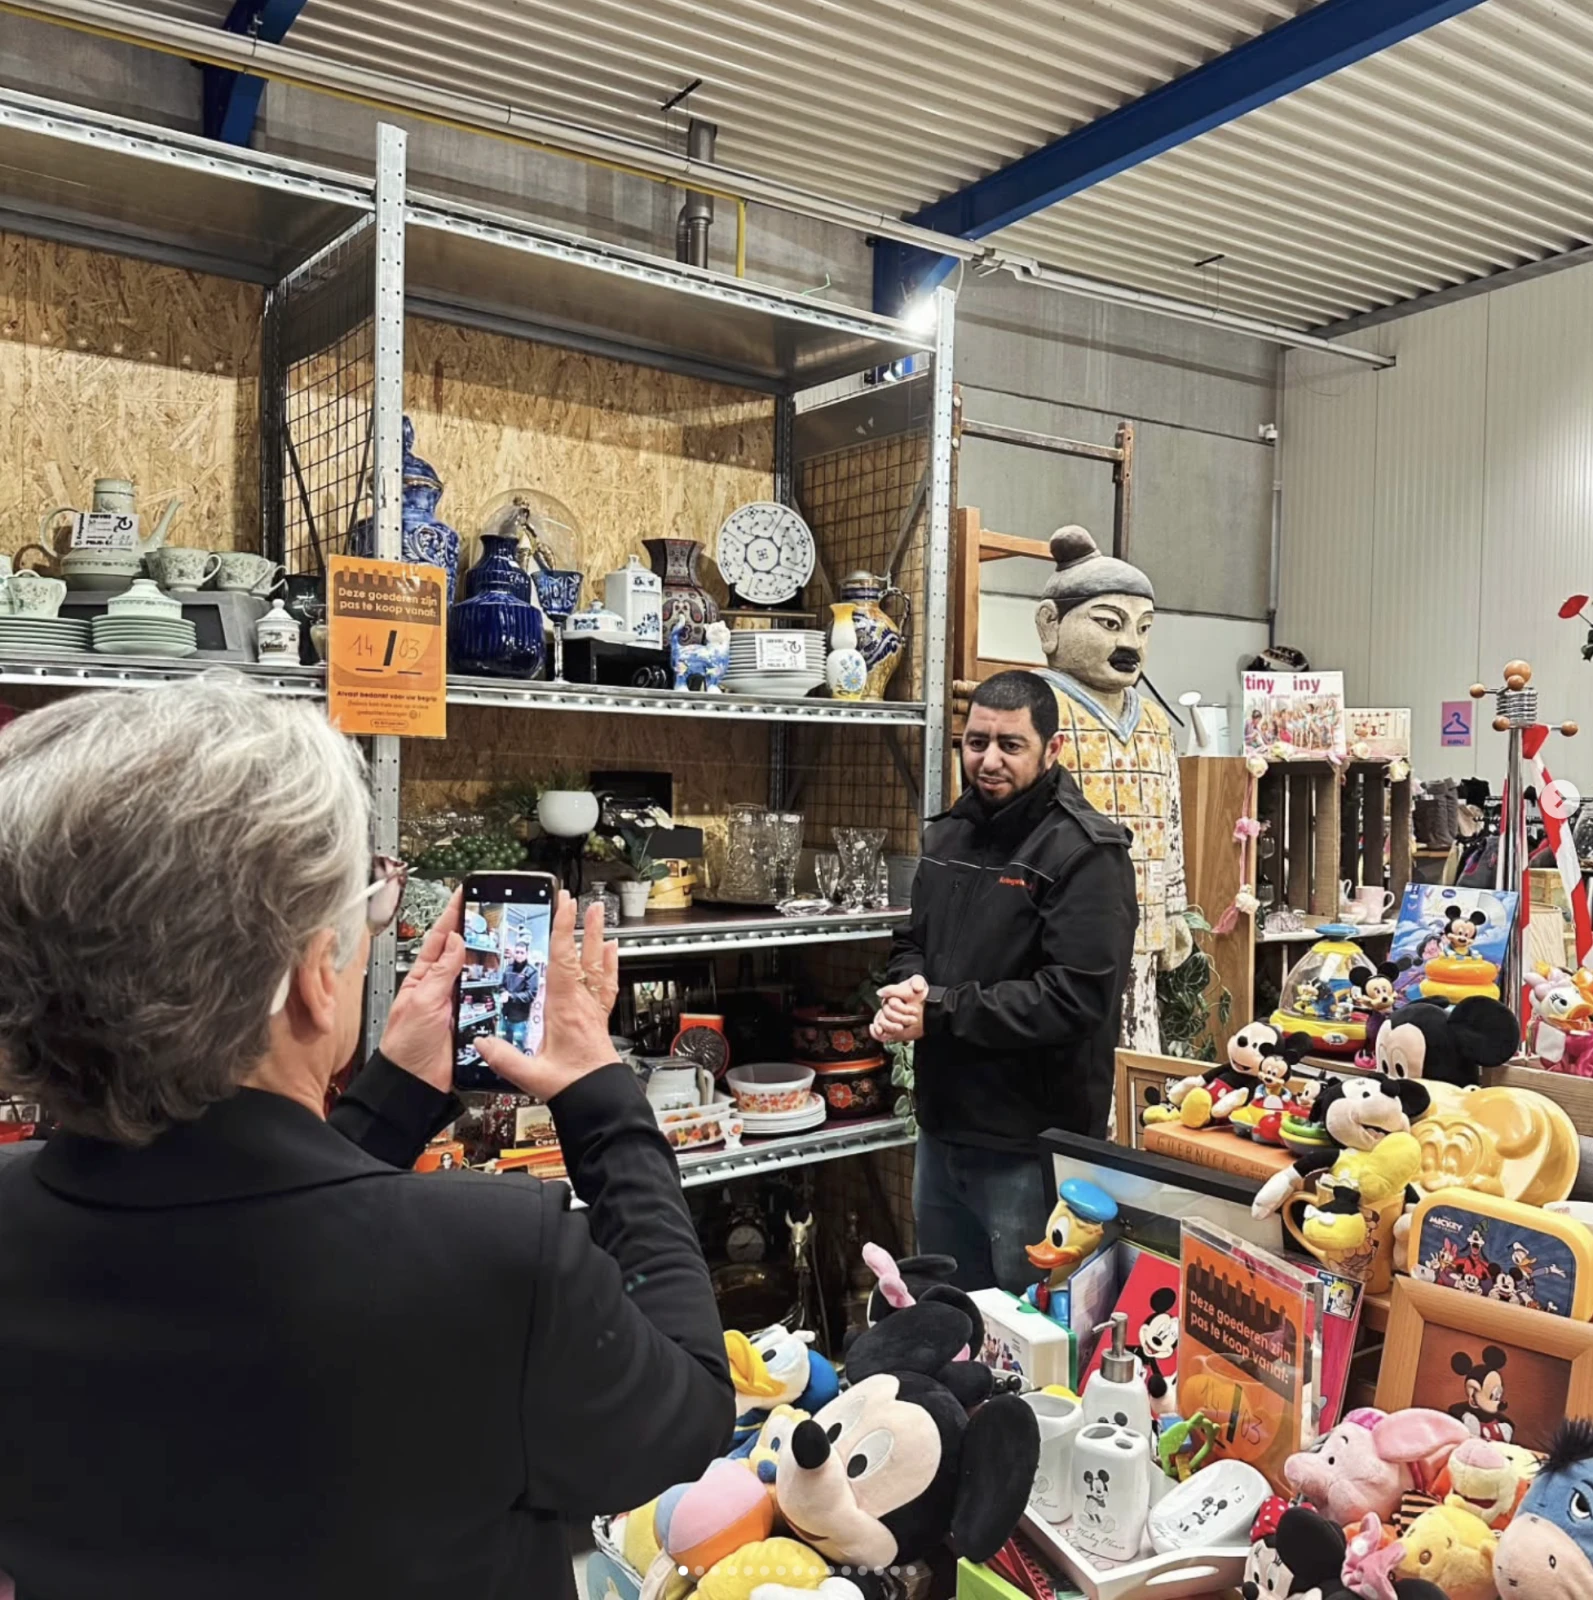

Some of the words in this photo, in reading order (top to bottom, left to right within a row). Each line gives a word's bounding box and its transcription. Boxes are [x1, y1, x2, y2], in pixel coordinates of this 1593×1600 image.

[338, 587, 366, 599] Deze
[368, 589, 419, 605] goederen
[421, 595, 438, 607] zijn
[340, 600, 360, 610] pas
[362, 601, 373, 610] te
[375, 603, 403, 614] koop
[350, 634, 373, 657] 14
[399, 638, 420, 660] 03
[1245, 674, 1275, 694] tiny
[1293, 675, 1321, 694] iny
[1156, 1135, 1228, 1171] GUERNICA
[1429, 1216, 1464, 1232] MICKEY
[1190, 1289, 1215, 1317] Deze
[1216, 1309, 1269, 1353] goederen
[1270, 1340, 1292, 1366] zijn
[1190, 1312, 1210, 1335] pas
[1210, 1322, 1221, 1339] te
[1222, 1330, 1251, 1359] koop
[1253, 1350, 1290, 1385] vanaf:
[1240, 1408, 1264, 1445] 03
